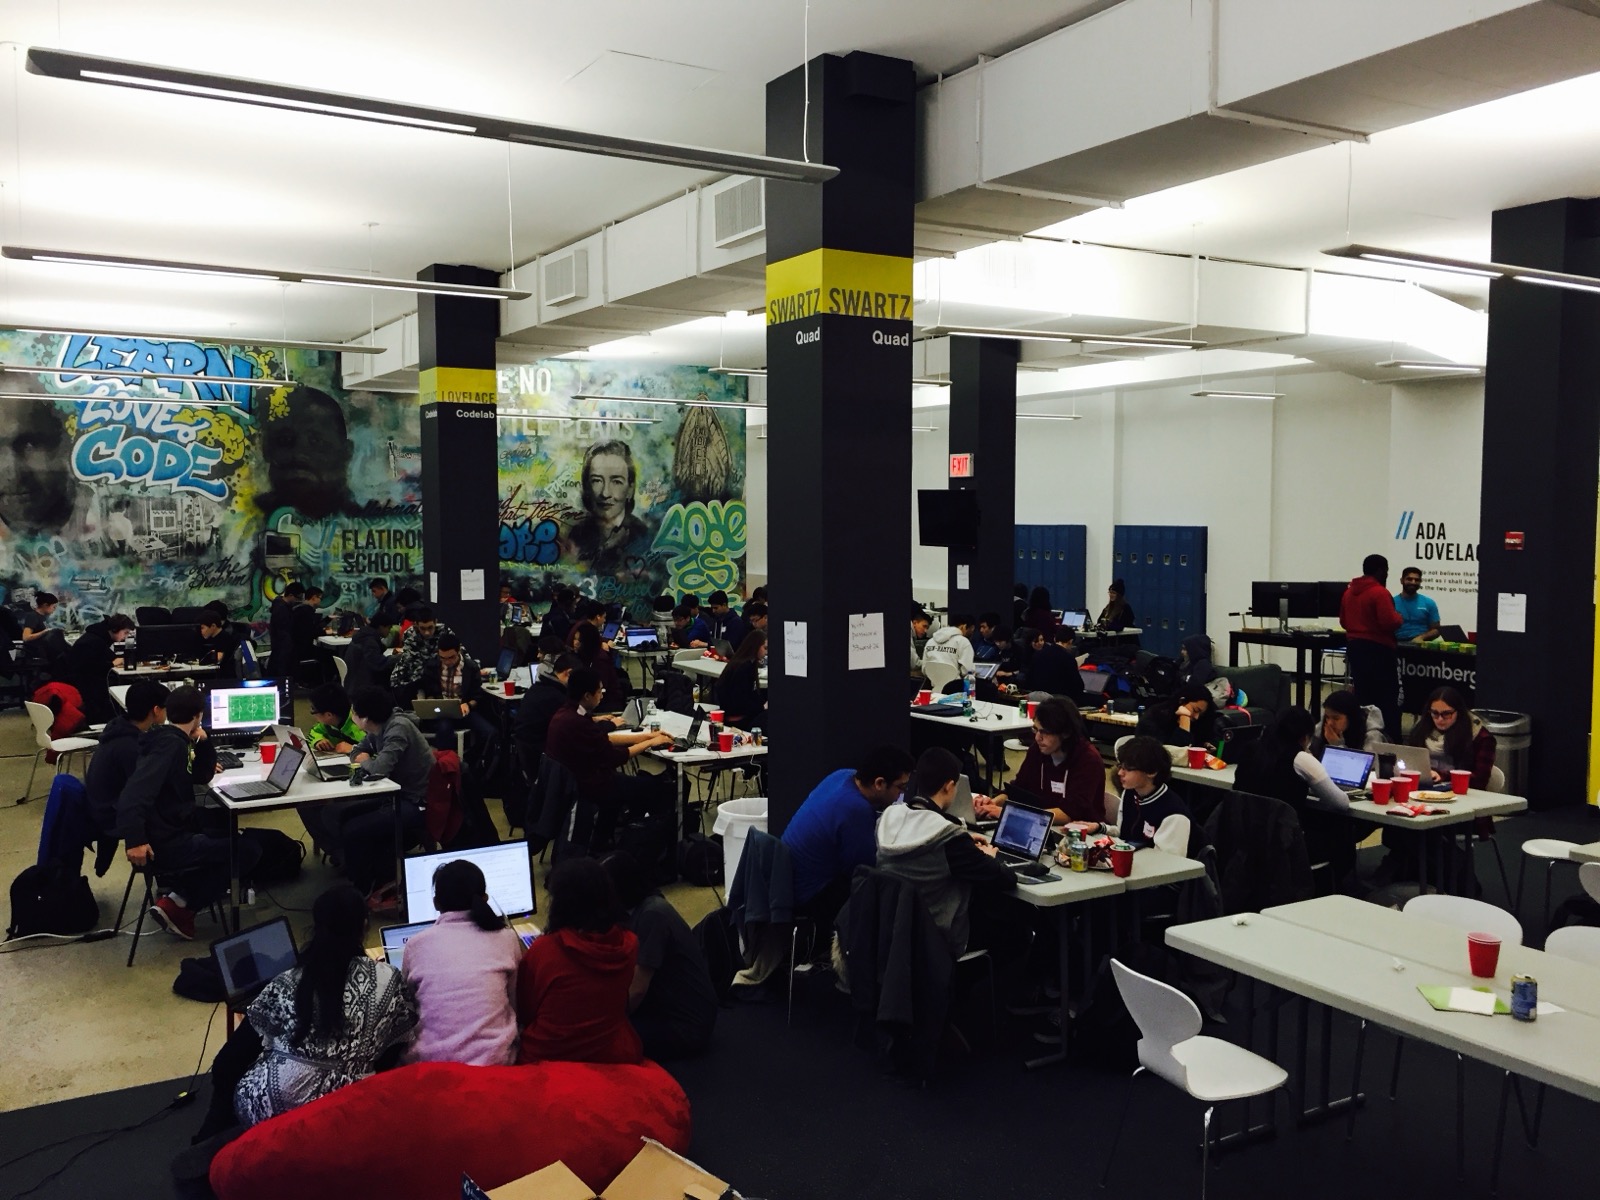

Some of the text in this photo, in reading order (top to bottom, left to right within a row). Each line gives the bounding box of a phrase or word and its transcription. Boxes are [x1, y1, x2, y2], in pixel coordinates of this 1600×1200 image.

[770, 288, 820, 325] SWARTZ
[829, 287, 911, 320] SWARTZ
[796, 327, 820, 345] Quad
[872, 330, 910, 346] Quad
[519, 366, 552, 395] NO
[441, 390, 495, 404] LOVELACE
[456, 409, 495, 419] Codelab
[559, 409, 634, 440] PLANS
[71, 424, 229, 502] CODE
[953, 457, 968, 473] EXIT
[1416, 522, 1446, 540] ADA
[1416, 543, 1480, 562] LOVELA
[343, 553, 415, 573] SCHOOL
[1402, 657, 1476, 690] loomberg
